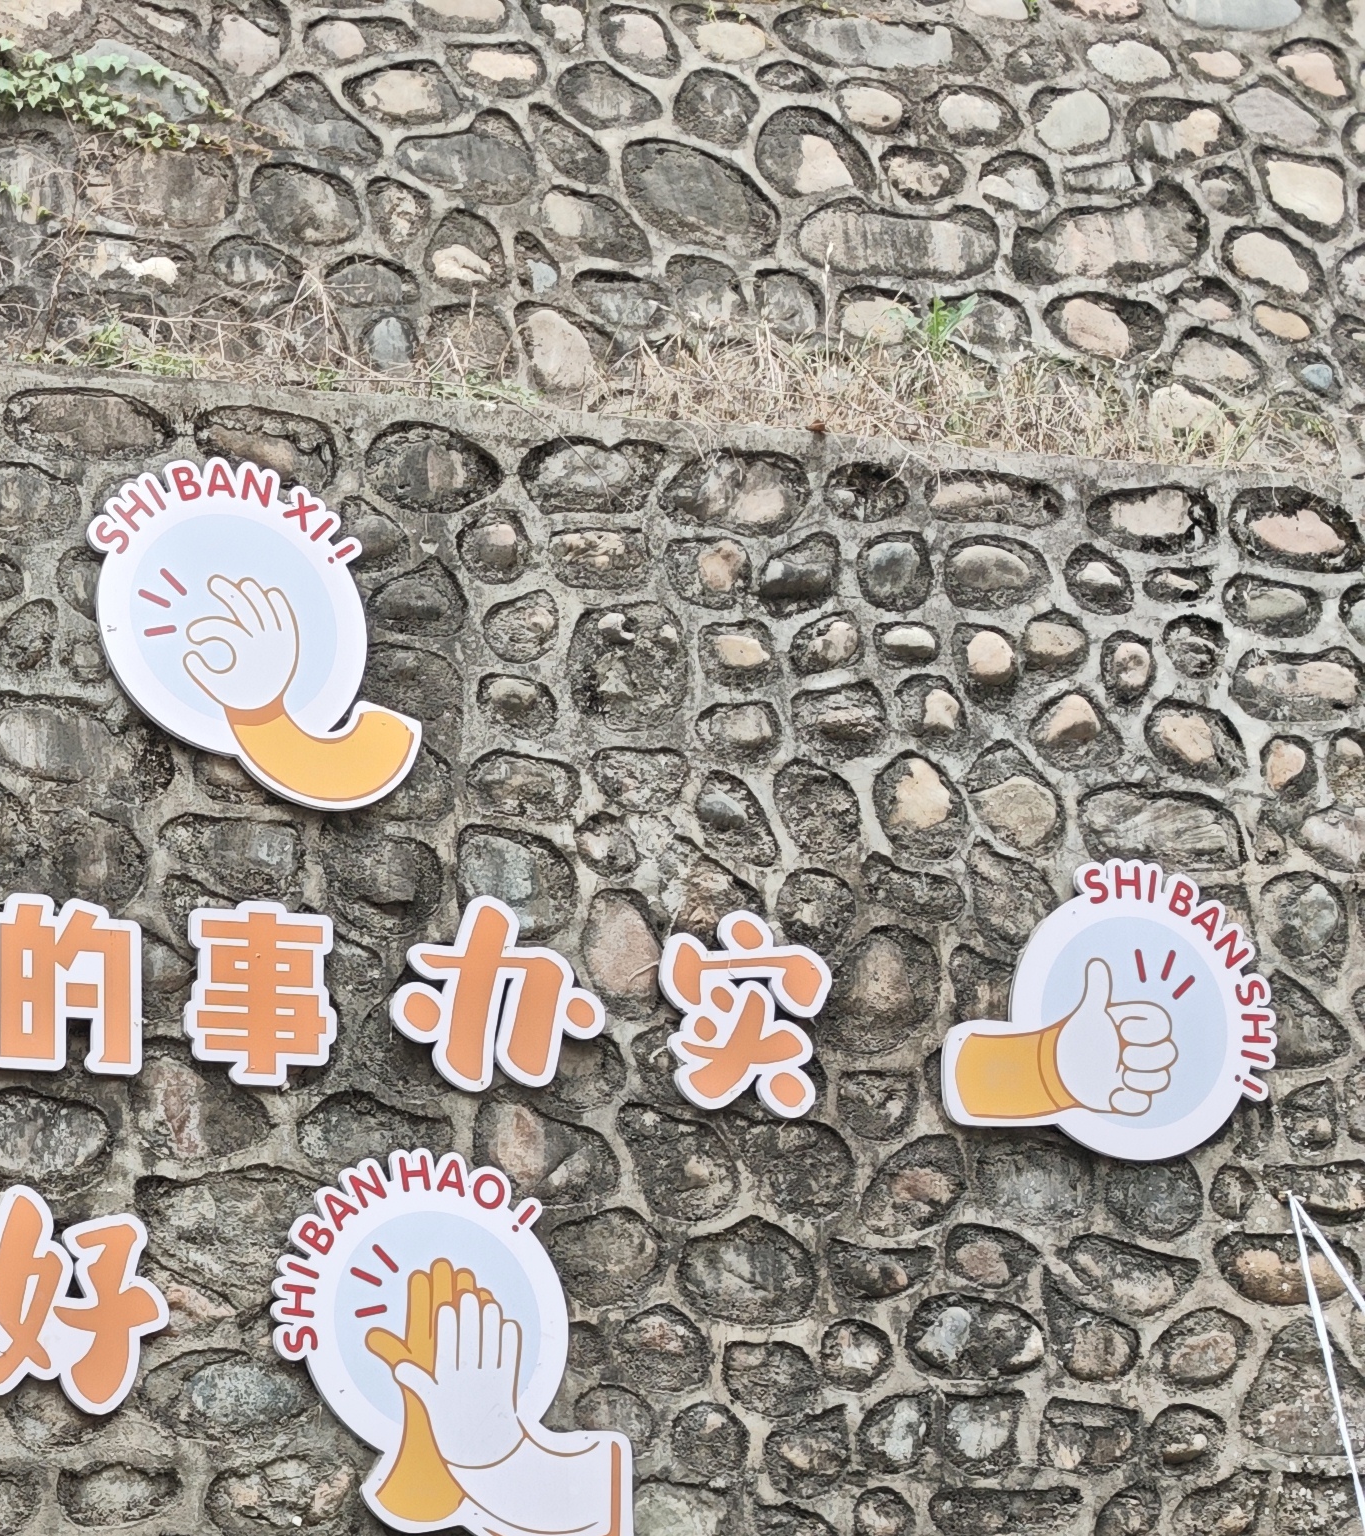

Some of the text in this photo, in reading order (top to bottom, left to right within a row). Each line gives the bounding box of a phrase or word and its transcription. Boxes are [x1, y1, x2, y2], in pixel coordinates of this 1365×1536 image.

[96, 478, 167, 555] SHI
[171, 462, 274, 508] BAN
[1083, 864, 1158, 904] SHI
[1168, 879, 1250, 970] BAN
[297, 1164, 388, 1256] BAN
[280, 1261, 320, 1354] SHI
